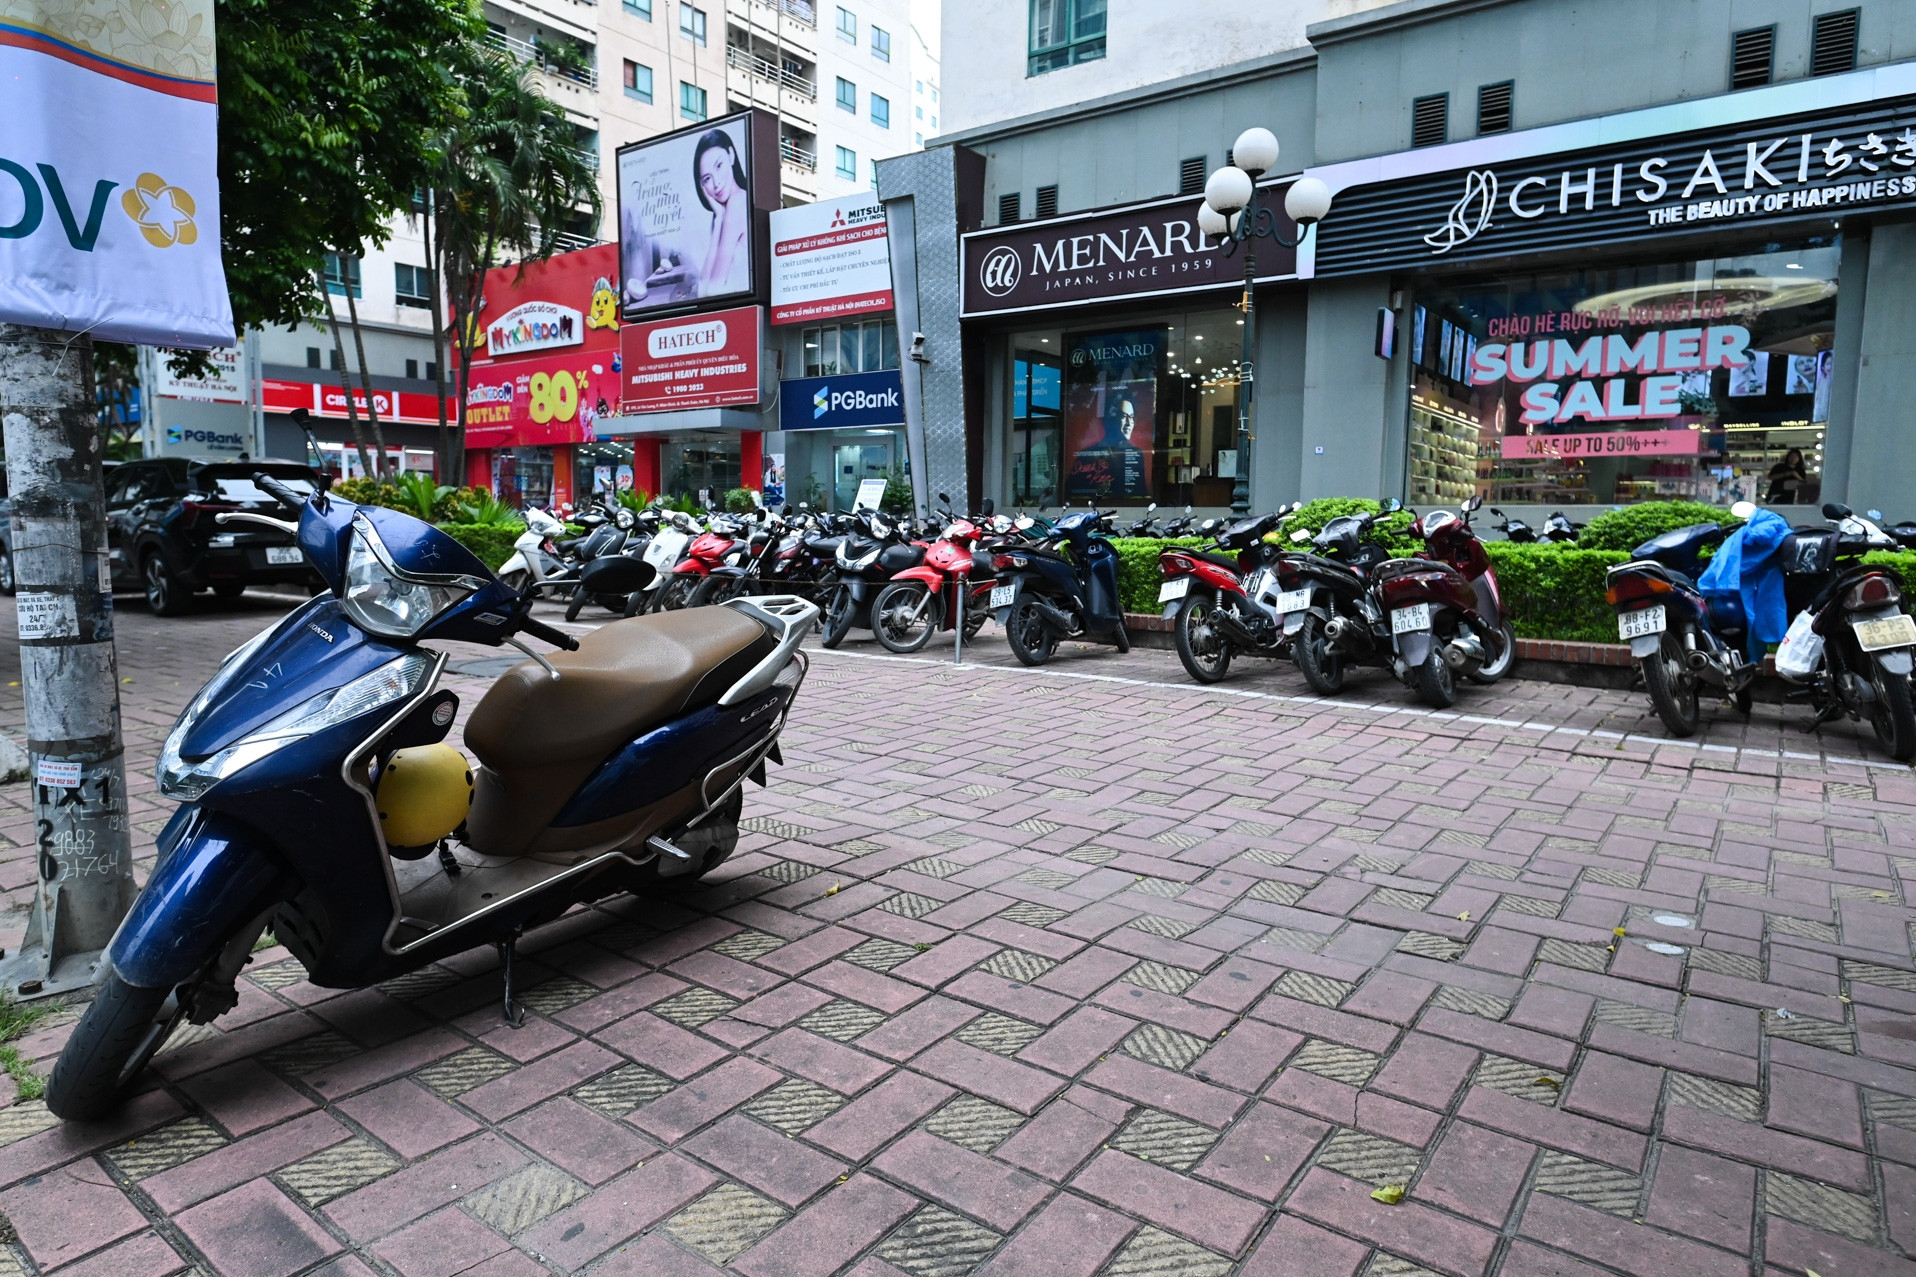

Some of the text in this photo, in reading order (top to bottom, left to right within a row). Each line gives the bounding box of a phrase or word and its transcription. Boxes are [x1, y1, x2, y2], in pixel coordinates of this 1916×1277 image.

[1508, 133, 1812, 219] CHISAKI
[1647, 175, 1916, 226] THE BEAUTY OF HAPPINESS
[848, 216, 868, 224] HEAVY
[861, 228, 874, 238] CHO
[1045, 258, 1213, 292] JAPAN, SINCE 1959
[491, 314, 573, 351] MYKINGDOM
[1488, 313, 1531, 338] CHÀO
[1534, 311, 1556, 333] HÈ
[1560, 311, 1593, 335] RỰC
[658, 329, 716, 350] HATECH
[1088, 343, 1155, 361] MENARD
[1470, 325, 1752, 386] SUMMER
[631, 363, 748, 384] MITSUBISHI HEAVY INDUSTRIES
[326, 394, 369, 409] CIRLE
[467, 382, 513, 404] YKINGDOM
[831, 387, 899, 412] PGBank
[1519, 376, 1683, 426] SALE
[466, 405, 511, 425] OUTLET
[185, 429, 244, 444] PGBank
[1563, 438, 1582, 453] UP
[1585, 436, 1602, 453] TO
[1396, 606, 1423, 620] 34-B4
[1626, 608, 1658, 625] 88-F2
[307, 621, 334, 643] HONDA
